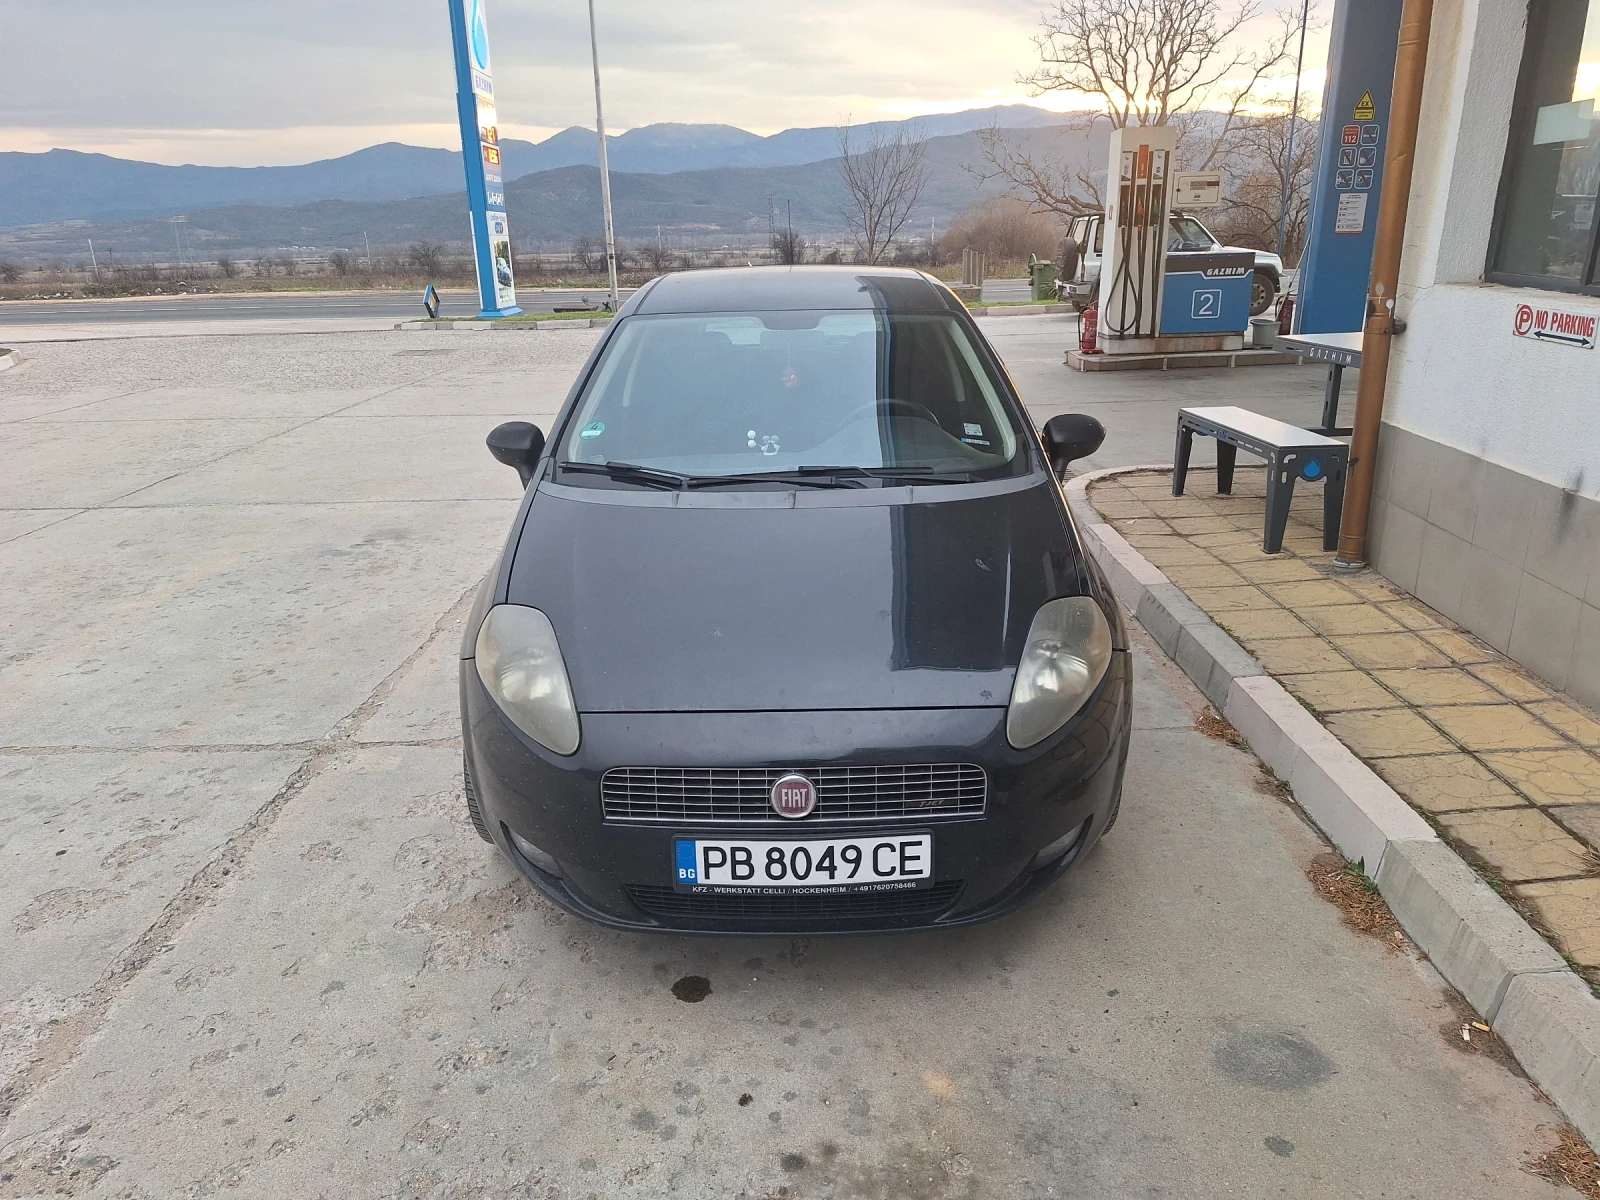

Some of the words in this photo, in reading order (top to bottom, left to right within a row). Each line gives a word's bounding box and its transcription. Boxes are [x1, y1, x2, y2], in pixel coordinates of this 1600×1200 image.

[1344, 135, 1357, 143] 112
[1206, 267, 1245, 276] GAZHIM
[1199, 293, 1214, 315] 2
[1534, 309, 1549, 330] NO
[1550, 311, 1595, 338] PARKING
[1309, 347, 1352, 365] GAZHIM
[781, 788, 808, 808] FIAT
[703, 846, 755, 881] PB
[764, 844, 863, 881] 8049
[872, 840, 923, 877] CE
[679, 868, 695, 879] BG
[713, 886, 761, 894] WERKSTATT
[792, 886, 847, 894] HOCKENHEIM
